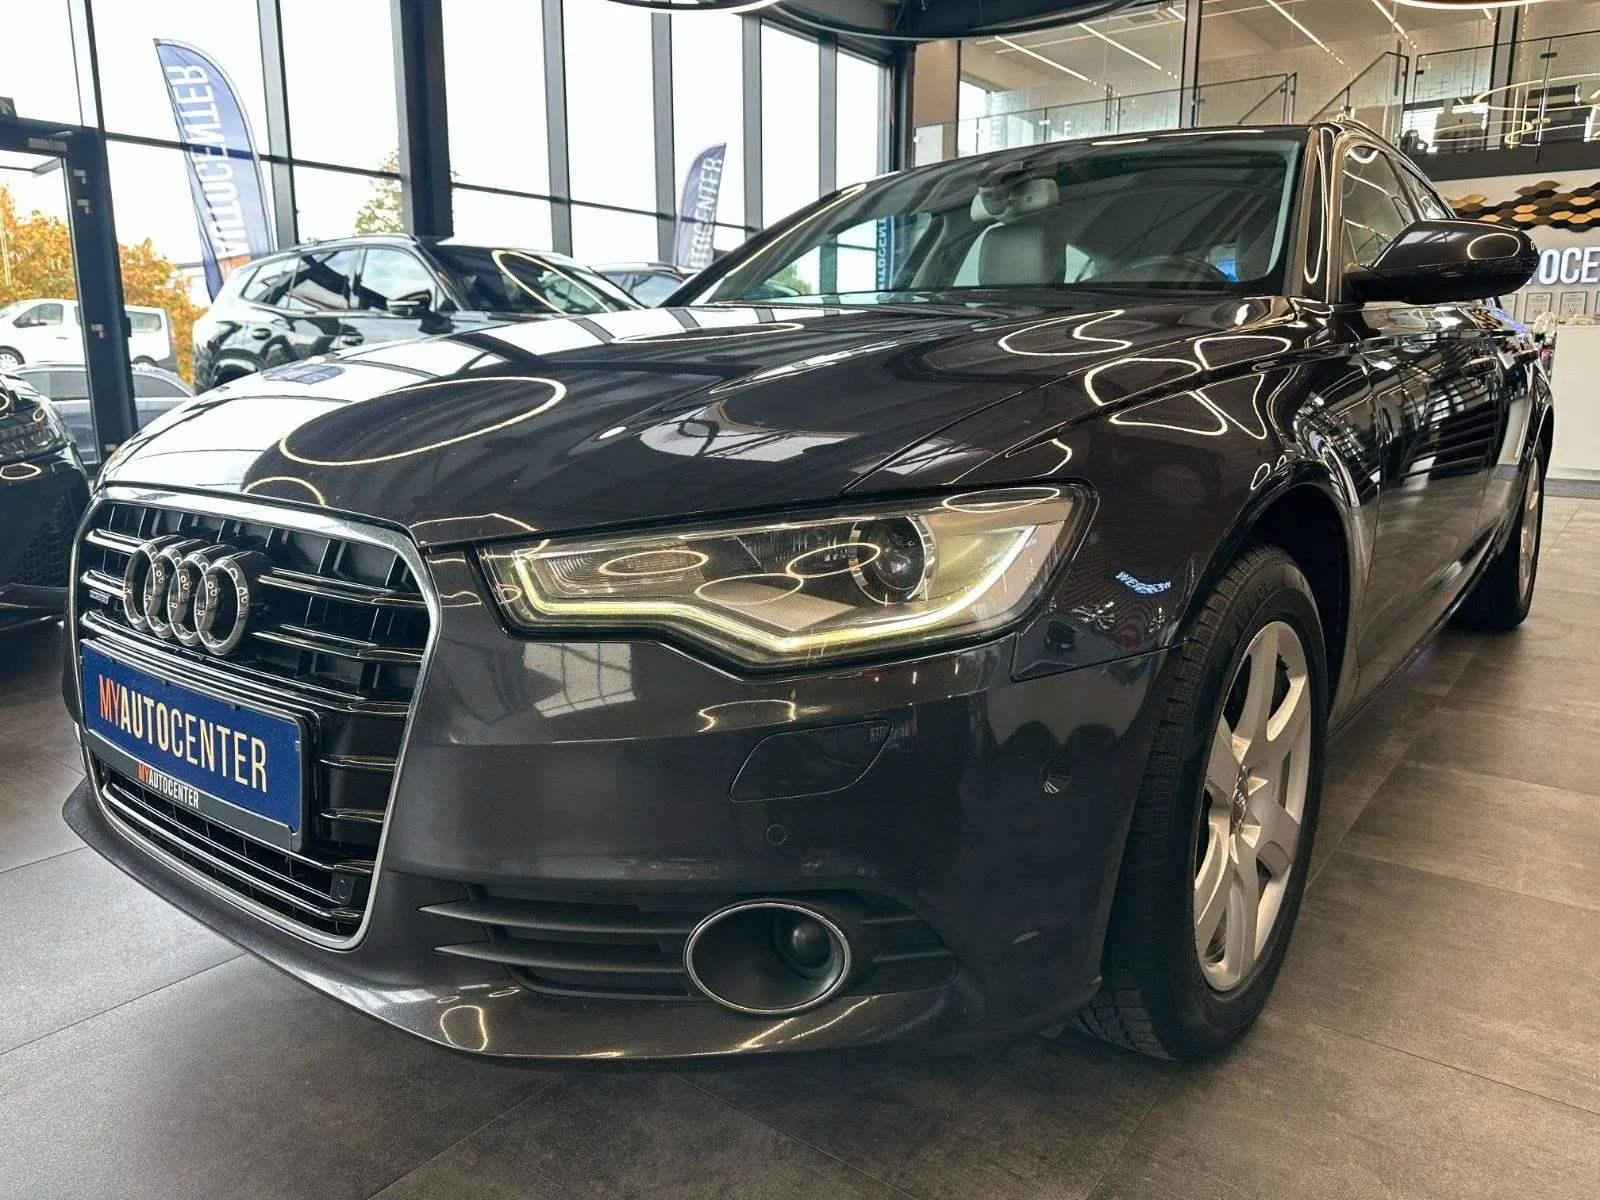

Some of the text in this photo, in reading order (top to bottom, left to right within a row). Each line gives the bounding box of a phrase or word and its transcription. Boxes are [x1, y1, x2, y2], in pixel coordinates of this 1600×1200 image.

[1527, 246, 1600, 285] OCE
[99, 674, 267, 793] MYAUTOCENTER
[137, 764, 199, 809] MYAUTOCENTER
